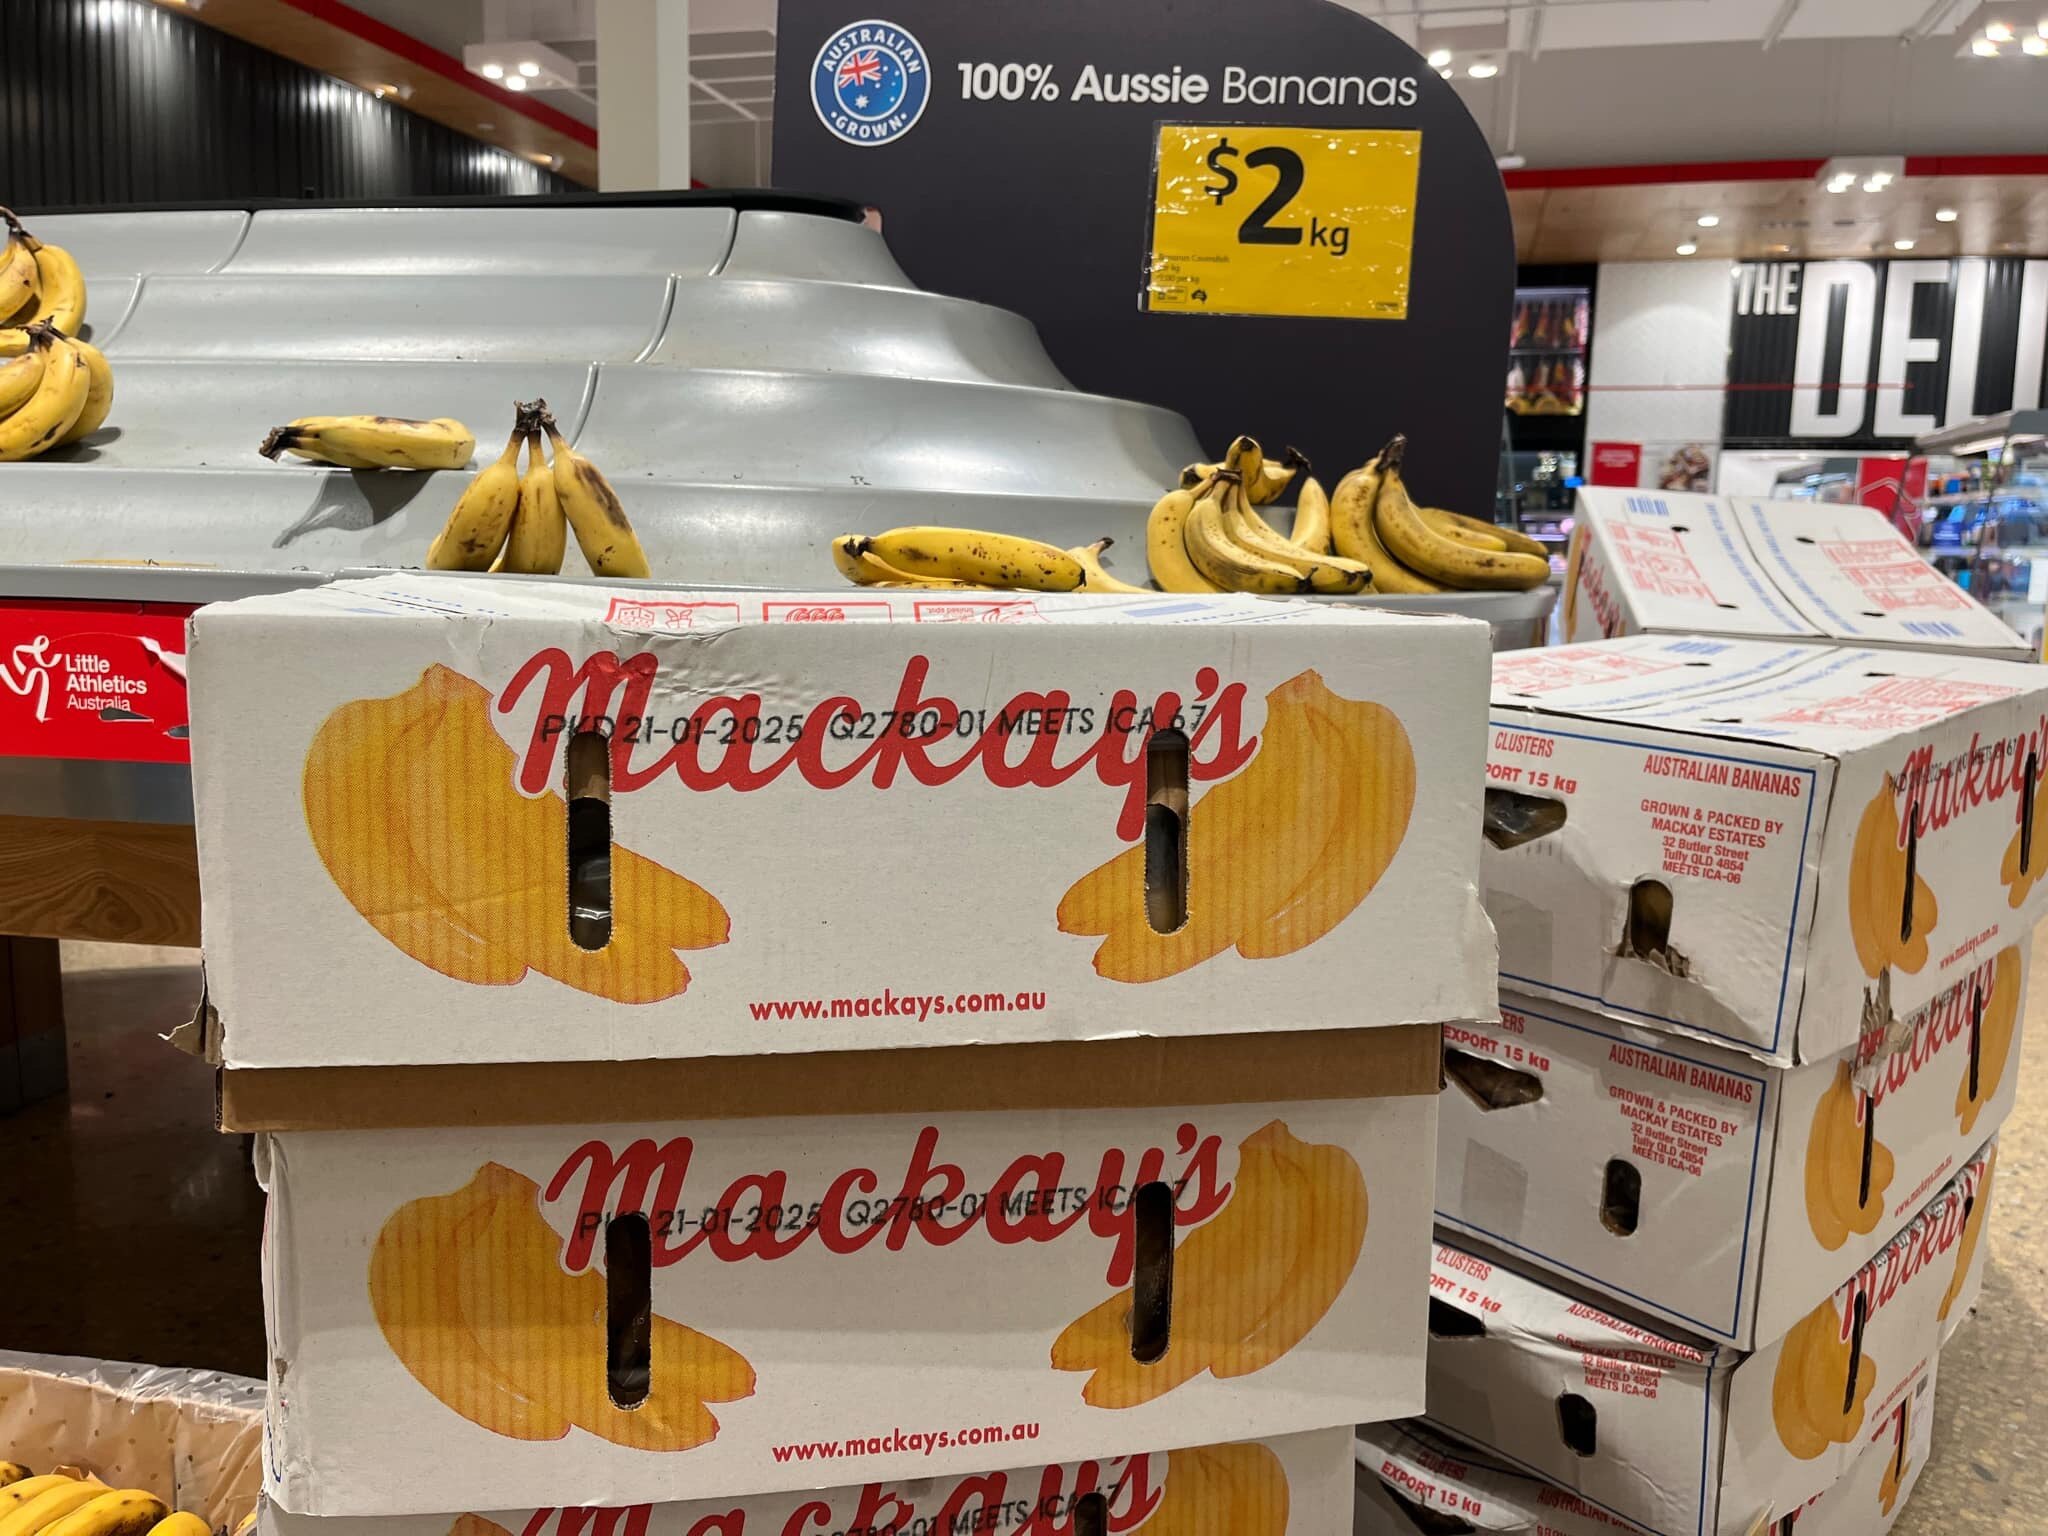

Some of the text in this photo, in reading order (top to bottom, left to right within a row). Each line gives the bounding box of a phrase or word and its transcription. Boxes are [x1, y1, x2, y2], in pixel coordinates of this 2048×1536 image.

[822, 28, 921, 73] AUSTRALIAN
[957, 62, 1418, 106] 100% Aussie Bananas
[835, 115, 903, 139] GROWN
[1204, 138, 1350, 256] $2 kg
[1730, 262, 1800, 315] THE
[65, 653, 110, 673] Little
[65, 673, 148, 694] Athletics
[66, 693, 131, 711] Australia
[622, 712, 804, 745] 21-01-2025
[829, 708, 987, 742] Q2780-01
[997, 706, 1095, 736] MEETS
[1104, 705, 1157, 734] ICA
[1165, 702, 1208, 731] 67
[497, 647, 1258, 842] Mackay's
[1494, 731, 1555, 758] CLUSTERS
[1486, 762, 1578, 794] PORT 15 kg
[1643, 754, 1801, 798] AUSTRALIAN BANANAS
[1640, 799, 1784, 835] GROWN & PACKED BY
[1651, 817, 1767, 849] MACKAY ESTATES
[1662, 835, 1750, 862] 32 Butler Street
[1664, 848, 1689, 864] Tully
[1662, 860, 1742, 885] MEETS ICA-06
[749, 988, 1046, 1022] www.mackays.com.au
[1443, 1024, 1550, 1072] EXPORT 15 kg
[1608, 1043, 1753, 1103] AUSTRALIAN BANANAS
[1609, 1085, 1738, 1136] GROWN & PACKED BY
[1620, 1103, 1723, 1147] MACKAY ESTATES
[1631, 1144, 1666, 1165] MEETS
[544, 1123, 1232, 1288] Mackay's
[656, 1202, 822, 1237] 21-01-2025
[998, 1186, 1088, 1218] MEETS
[1436, 1247, 1492, 1281] CLUSTERS
[1458, 1287, 1479, 1303] 15
[1565, 1303, 1642, 1340] AUSTRALIAN
[1585, 1376, 1619, 1392] MEETS
[771, 1422, 1040, 1463] www.mackays.com.au
[1381, 1460, 1482, 1516] EXPORT 15 kg
